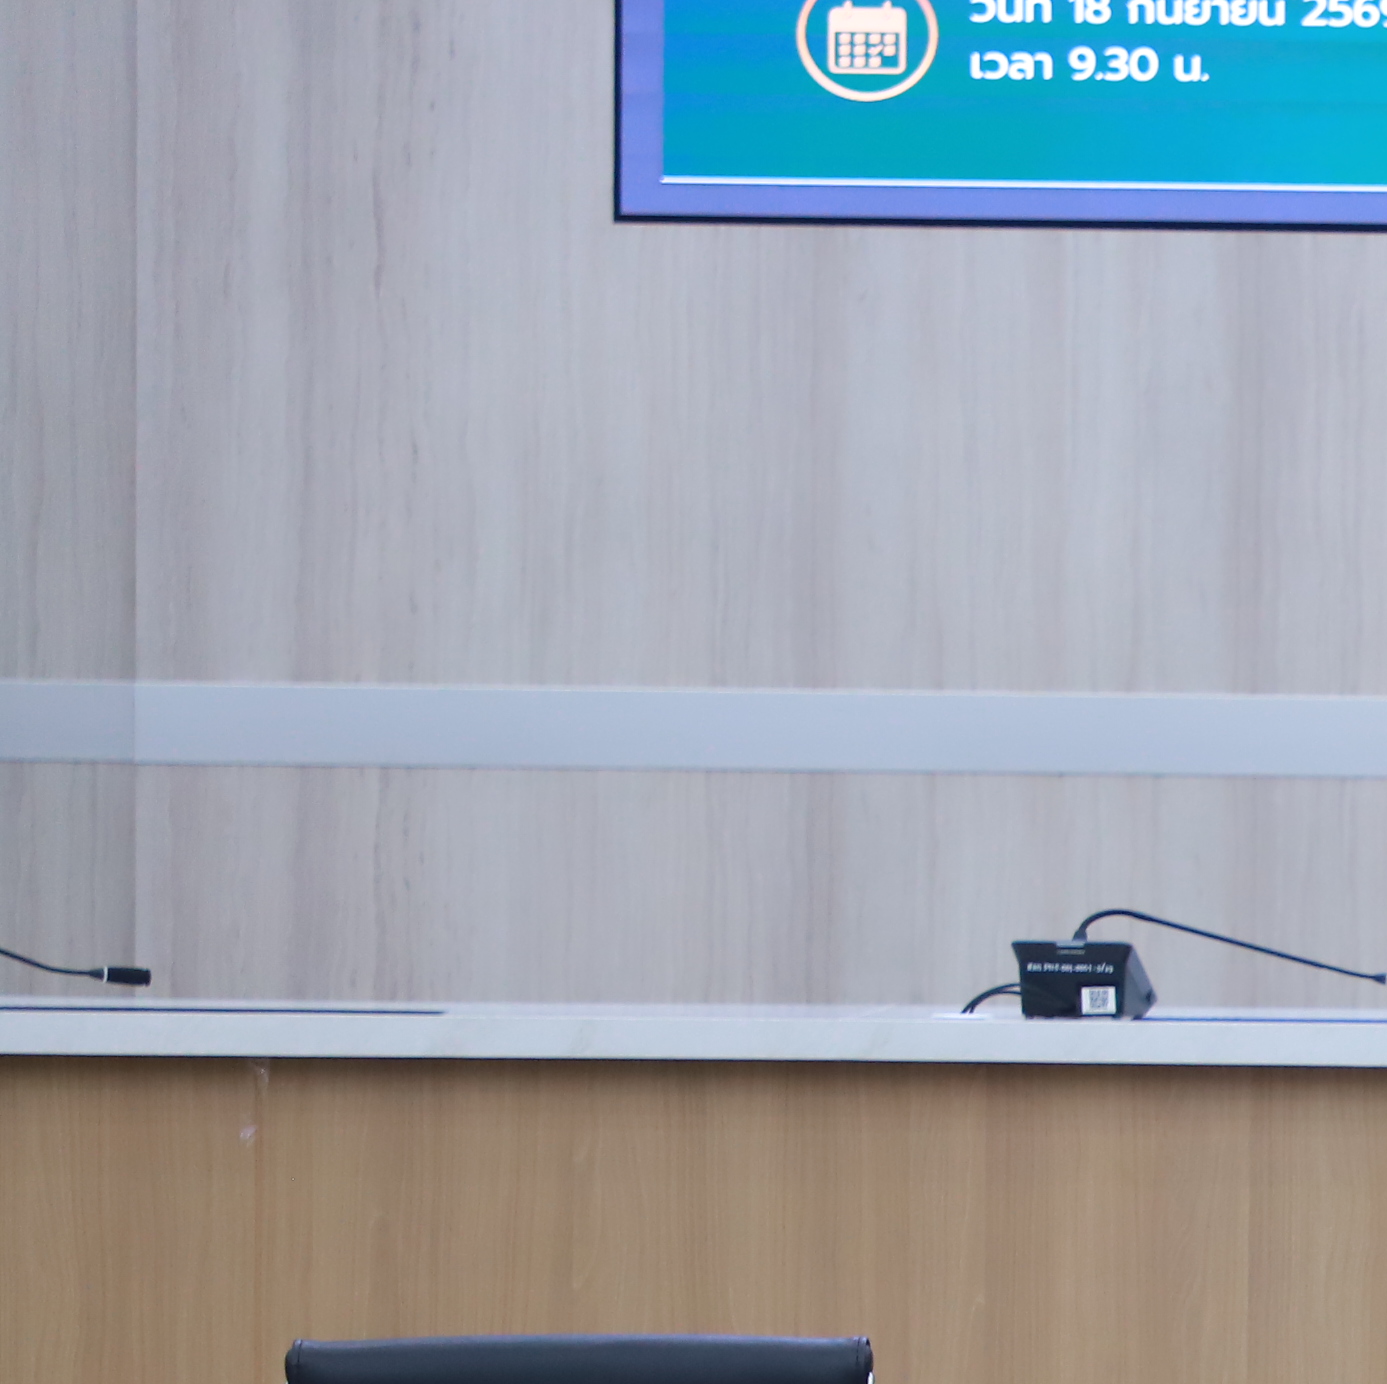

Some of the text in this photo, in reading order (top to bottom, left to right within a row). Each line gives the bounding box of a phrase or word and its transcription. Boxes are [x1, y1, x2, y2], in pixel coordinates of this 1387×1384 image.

[1126, 0, 1286, 26] กนยายน
[970, 46, 1210, 82] เวลา 9.30 น.
